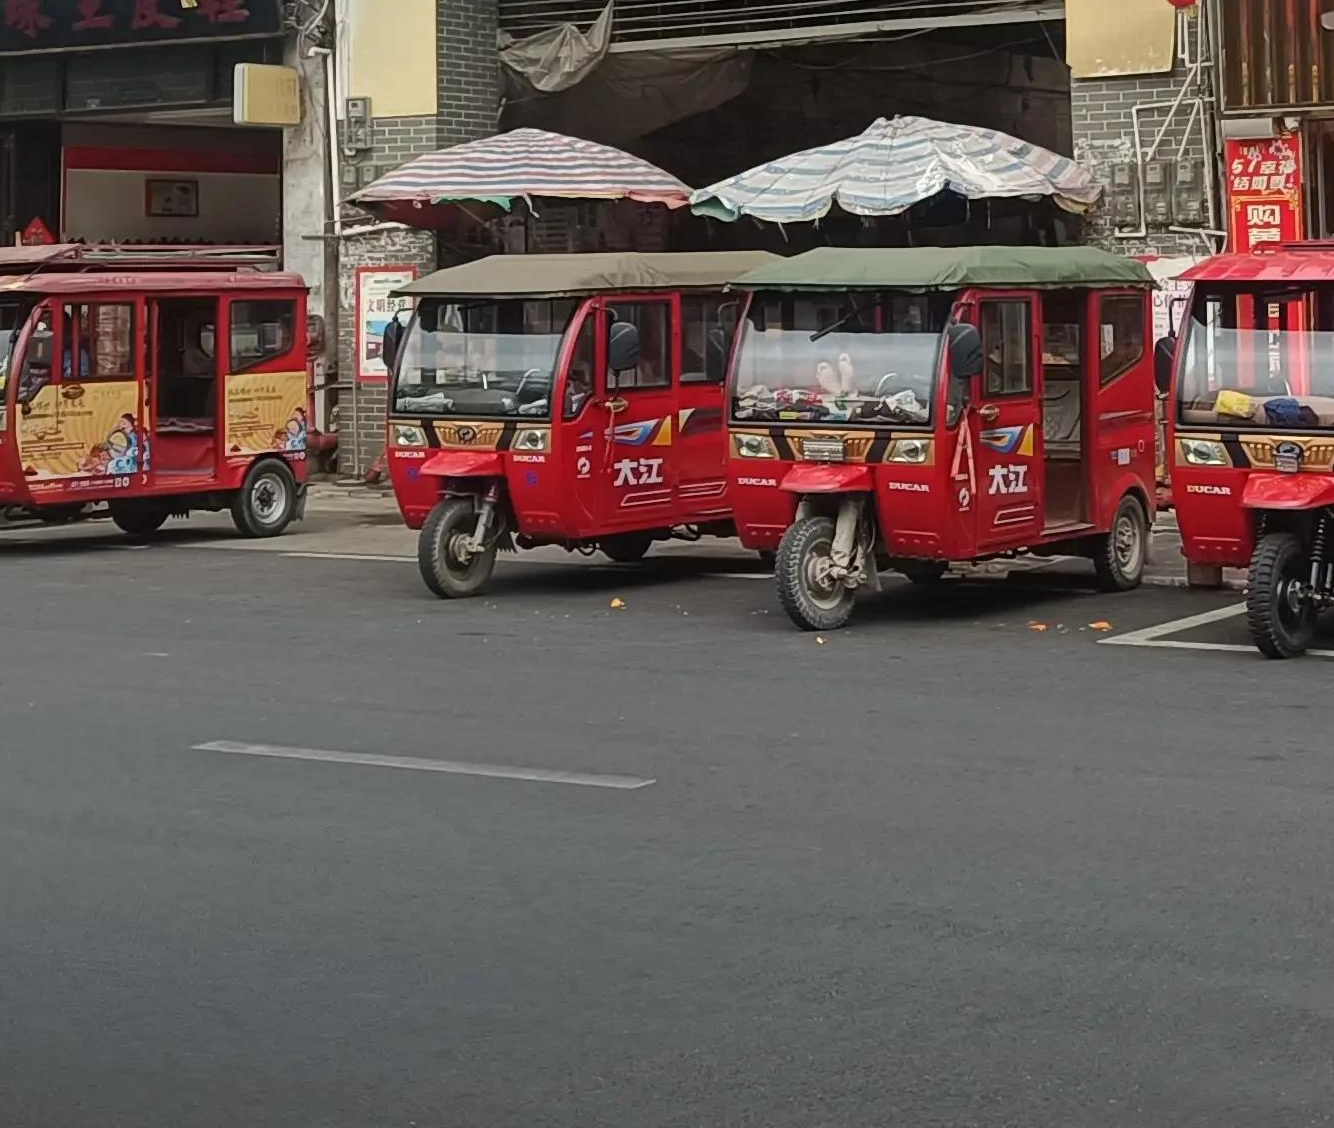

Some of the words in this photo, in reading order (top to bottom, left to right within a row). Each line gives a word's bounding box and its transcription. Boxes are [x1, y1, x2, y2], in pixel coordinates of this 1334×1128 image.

[613, 458, 664, 487] 大江
[738, 477, 777, 487] DUCAR
[988, 464, 1028, 494] 大江
[888, 482, 930, 493] DUCAR
[1187, 484, 1232, 496] DUCAR
